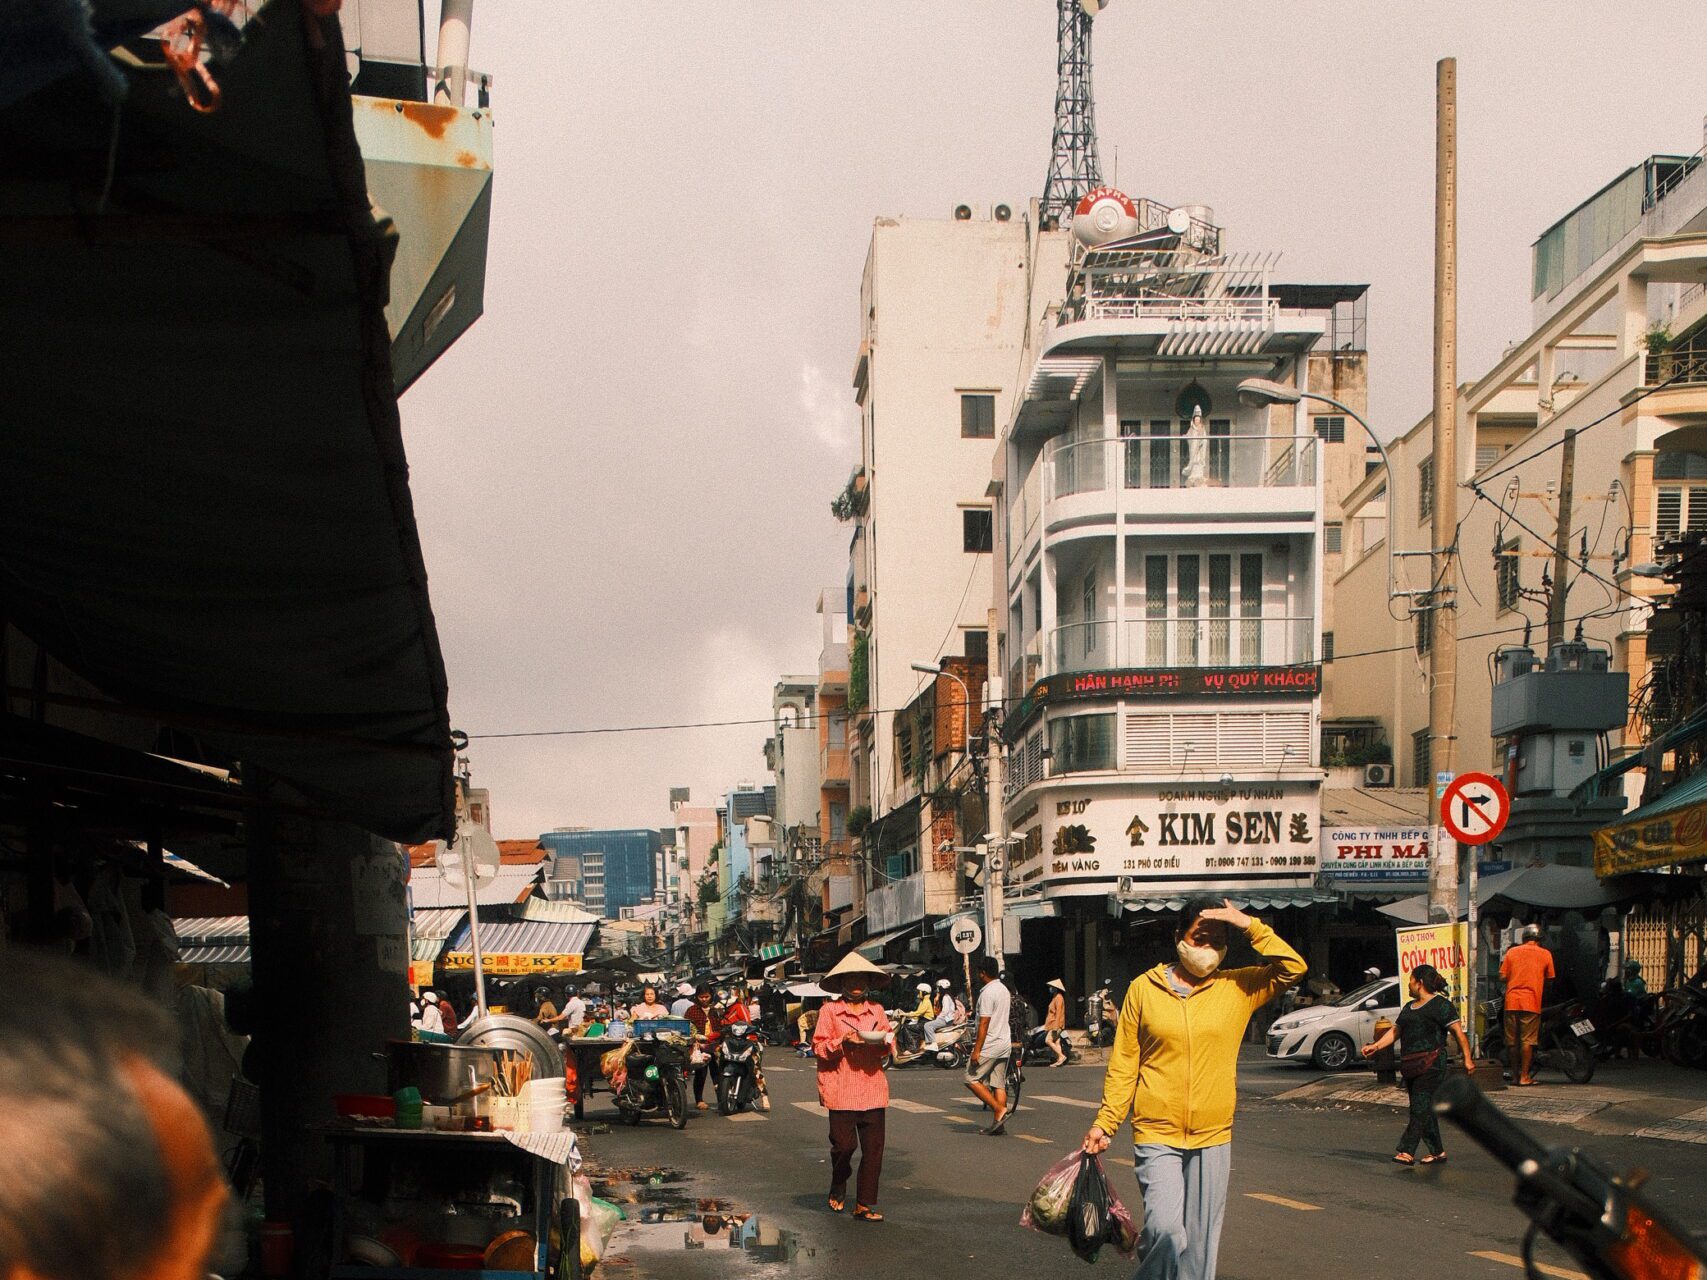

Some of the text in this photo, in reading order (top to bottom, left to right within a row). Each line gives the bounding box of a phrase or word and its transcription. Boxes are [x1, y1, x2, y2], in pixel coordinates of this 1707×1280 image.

[1204, 674, 1224, 690] VỤ
[1264, 669, 1316, 685] KHÁCH
[1158, 791, 1195, 801] DOANH
[1158, 811, 1282, 846] KIM SEN
[1332, 830, 1356, 840] CÔNG
[1360, 832, 1371, 840] TY
[1374, 832, 1398, 840] TNHH
[1401, 828, 1419, 840] BẾP
[1337, 842, 1429, 859] PHI MÃ
[1072, 858, 1100, 871] VÀNG
[1123, 859, 1135, 869] 131
[1237, 857, 1249, 866] 747
[1401, 945, 1427, 973] CƠM
